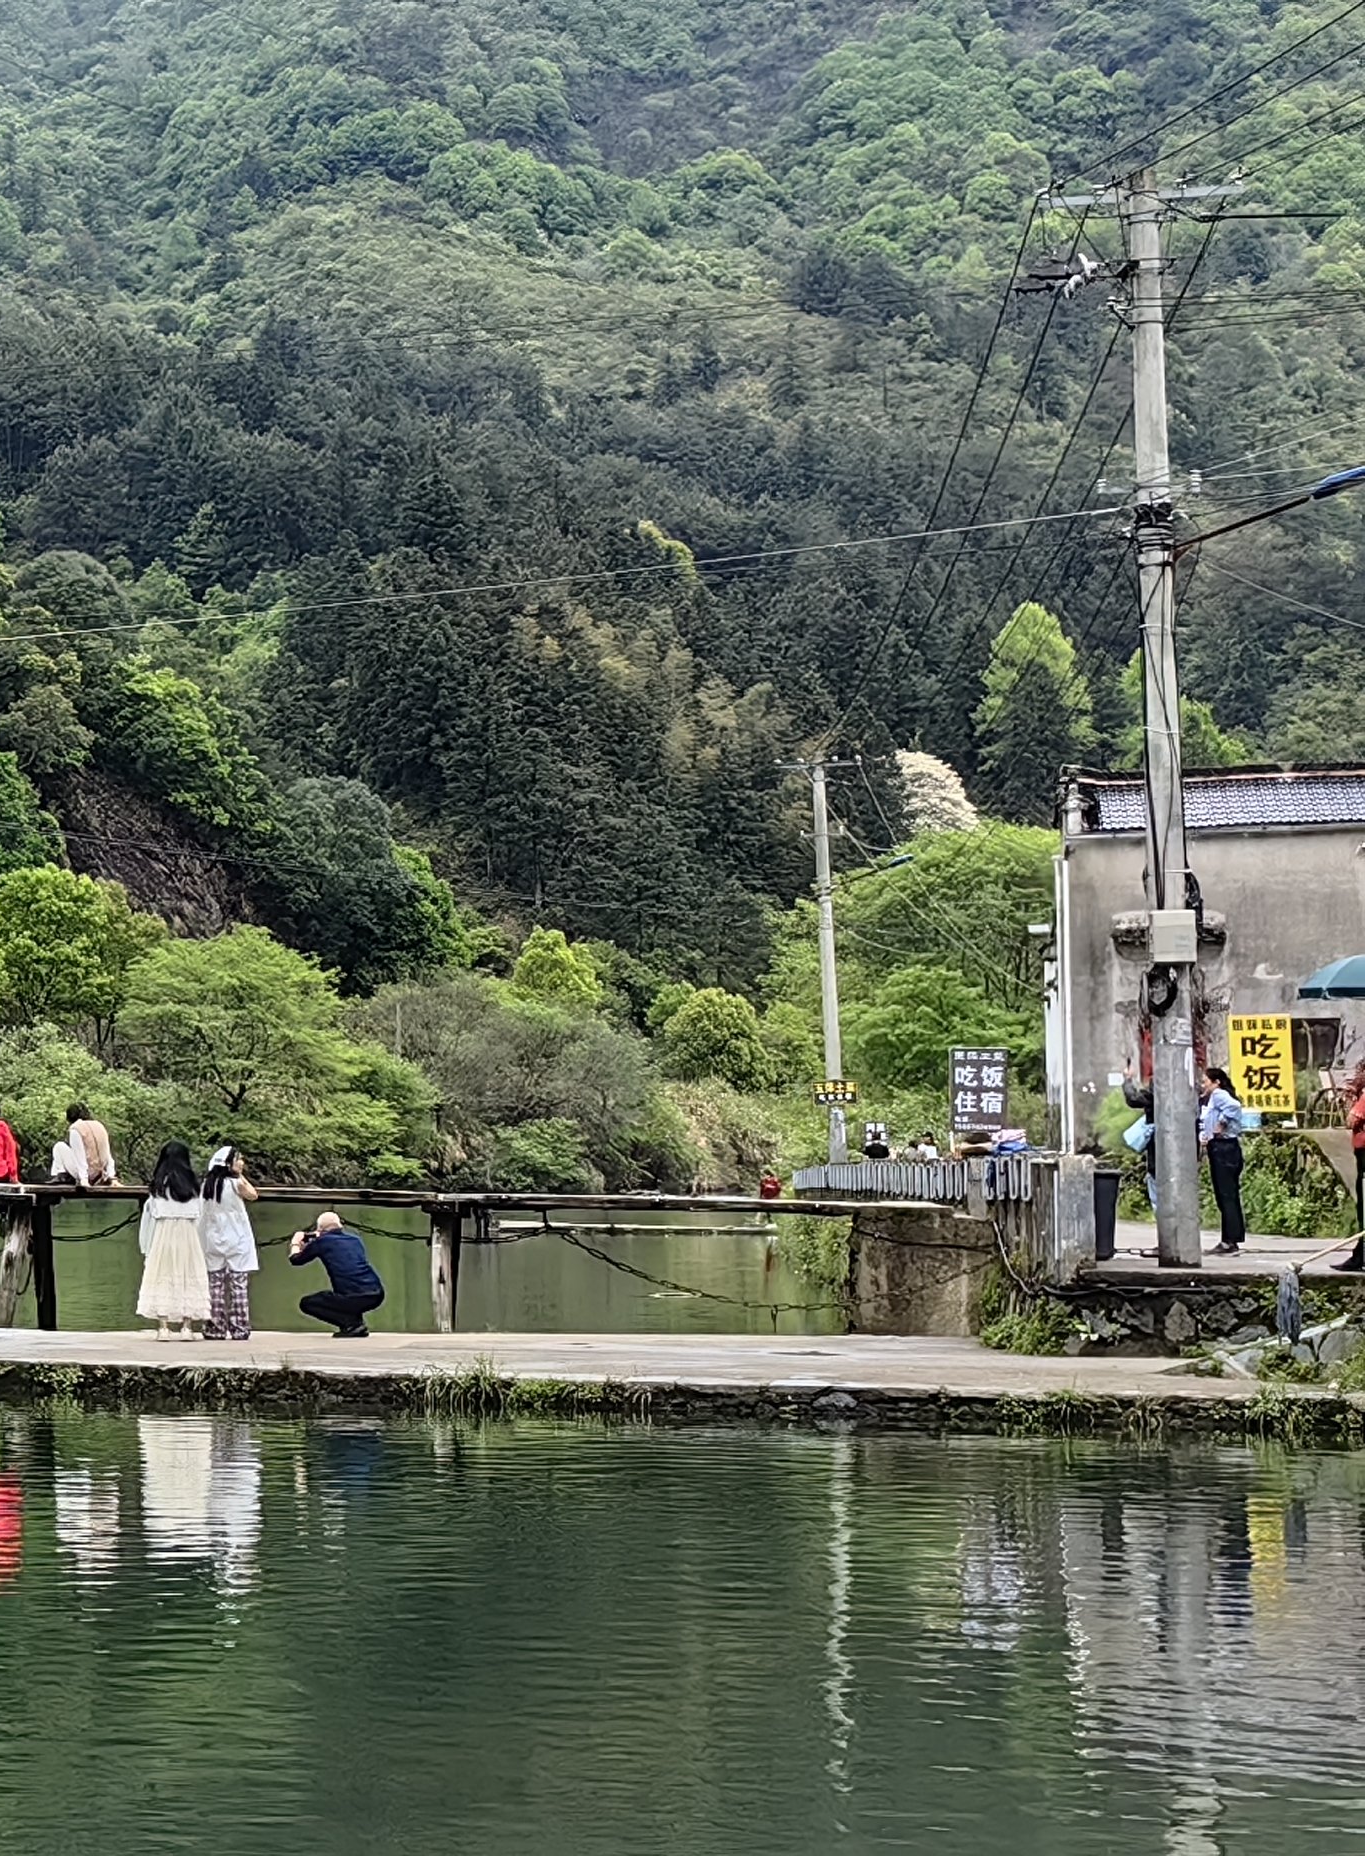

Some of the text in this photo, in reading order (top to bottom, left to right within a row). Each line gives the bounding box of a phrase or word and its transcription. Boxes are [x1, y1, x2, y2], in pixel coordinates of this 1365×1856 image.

[1241, 1033, 1283, 1090] 吃饭
[954, 1065, 1004, 1088] 吃饭
[954, 1091, 1004, 1114] 住宿
